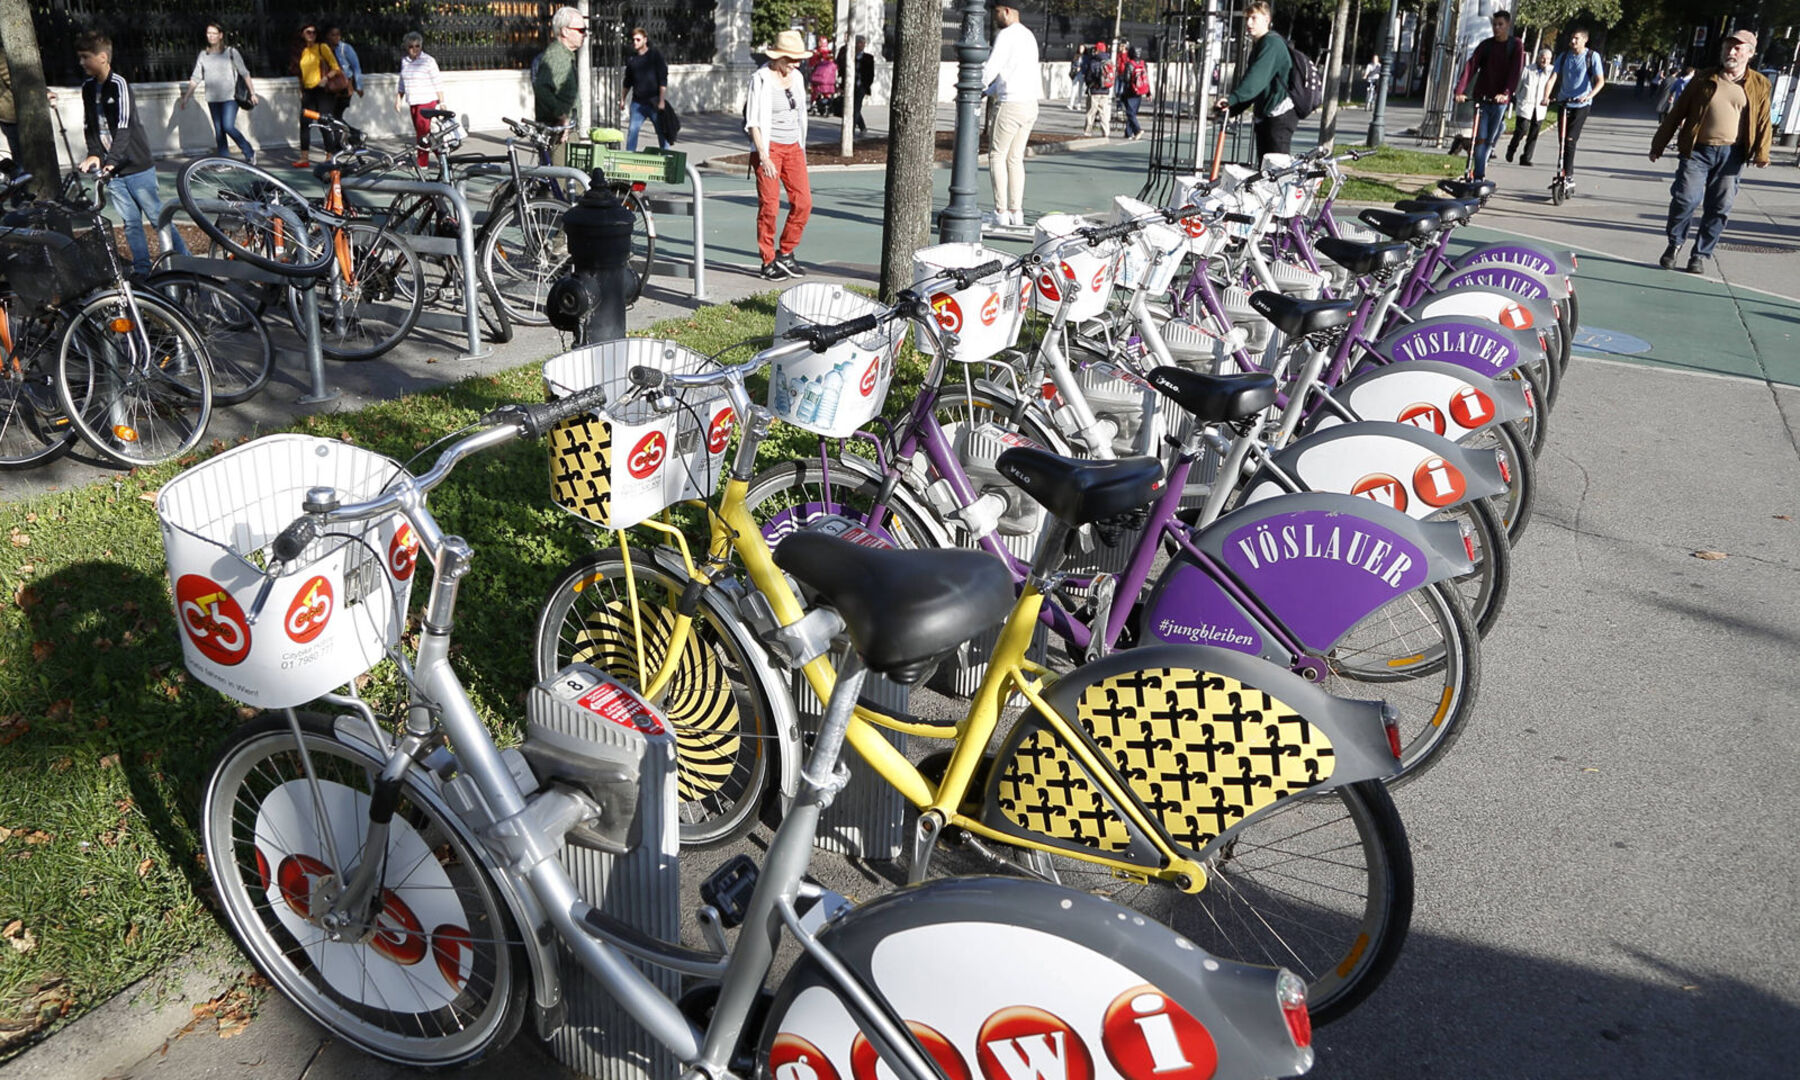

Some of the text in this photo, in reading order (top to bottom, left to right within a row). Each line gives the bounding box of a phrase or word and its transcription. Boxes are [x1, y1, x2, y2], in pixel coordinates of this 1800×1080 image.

[1472, 252, 1550, 276] ÖSLAUER
[1455, 274, 1541, 300] ÖSLAUER
[1401, 330, 1509, 368] VÖSLAUER
[1010, 464, 1031, 484] VELO
[1238, 524, 1413, 588] VÖSLAUER
[1159, 618, 1254, 647] #jungbleiben
[567, 680, 584, 692] 8
